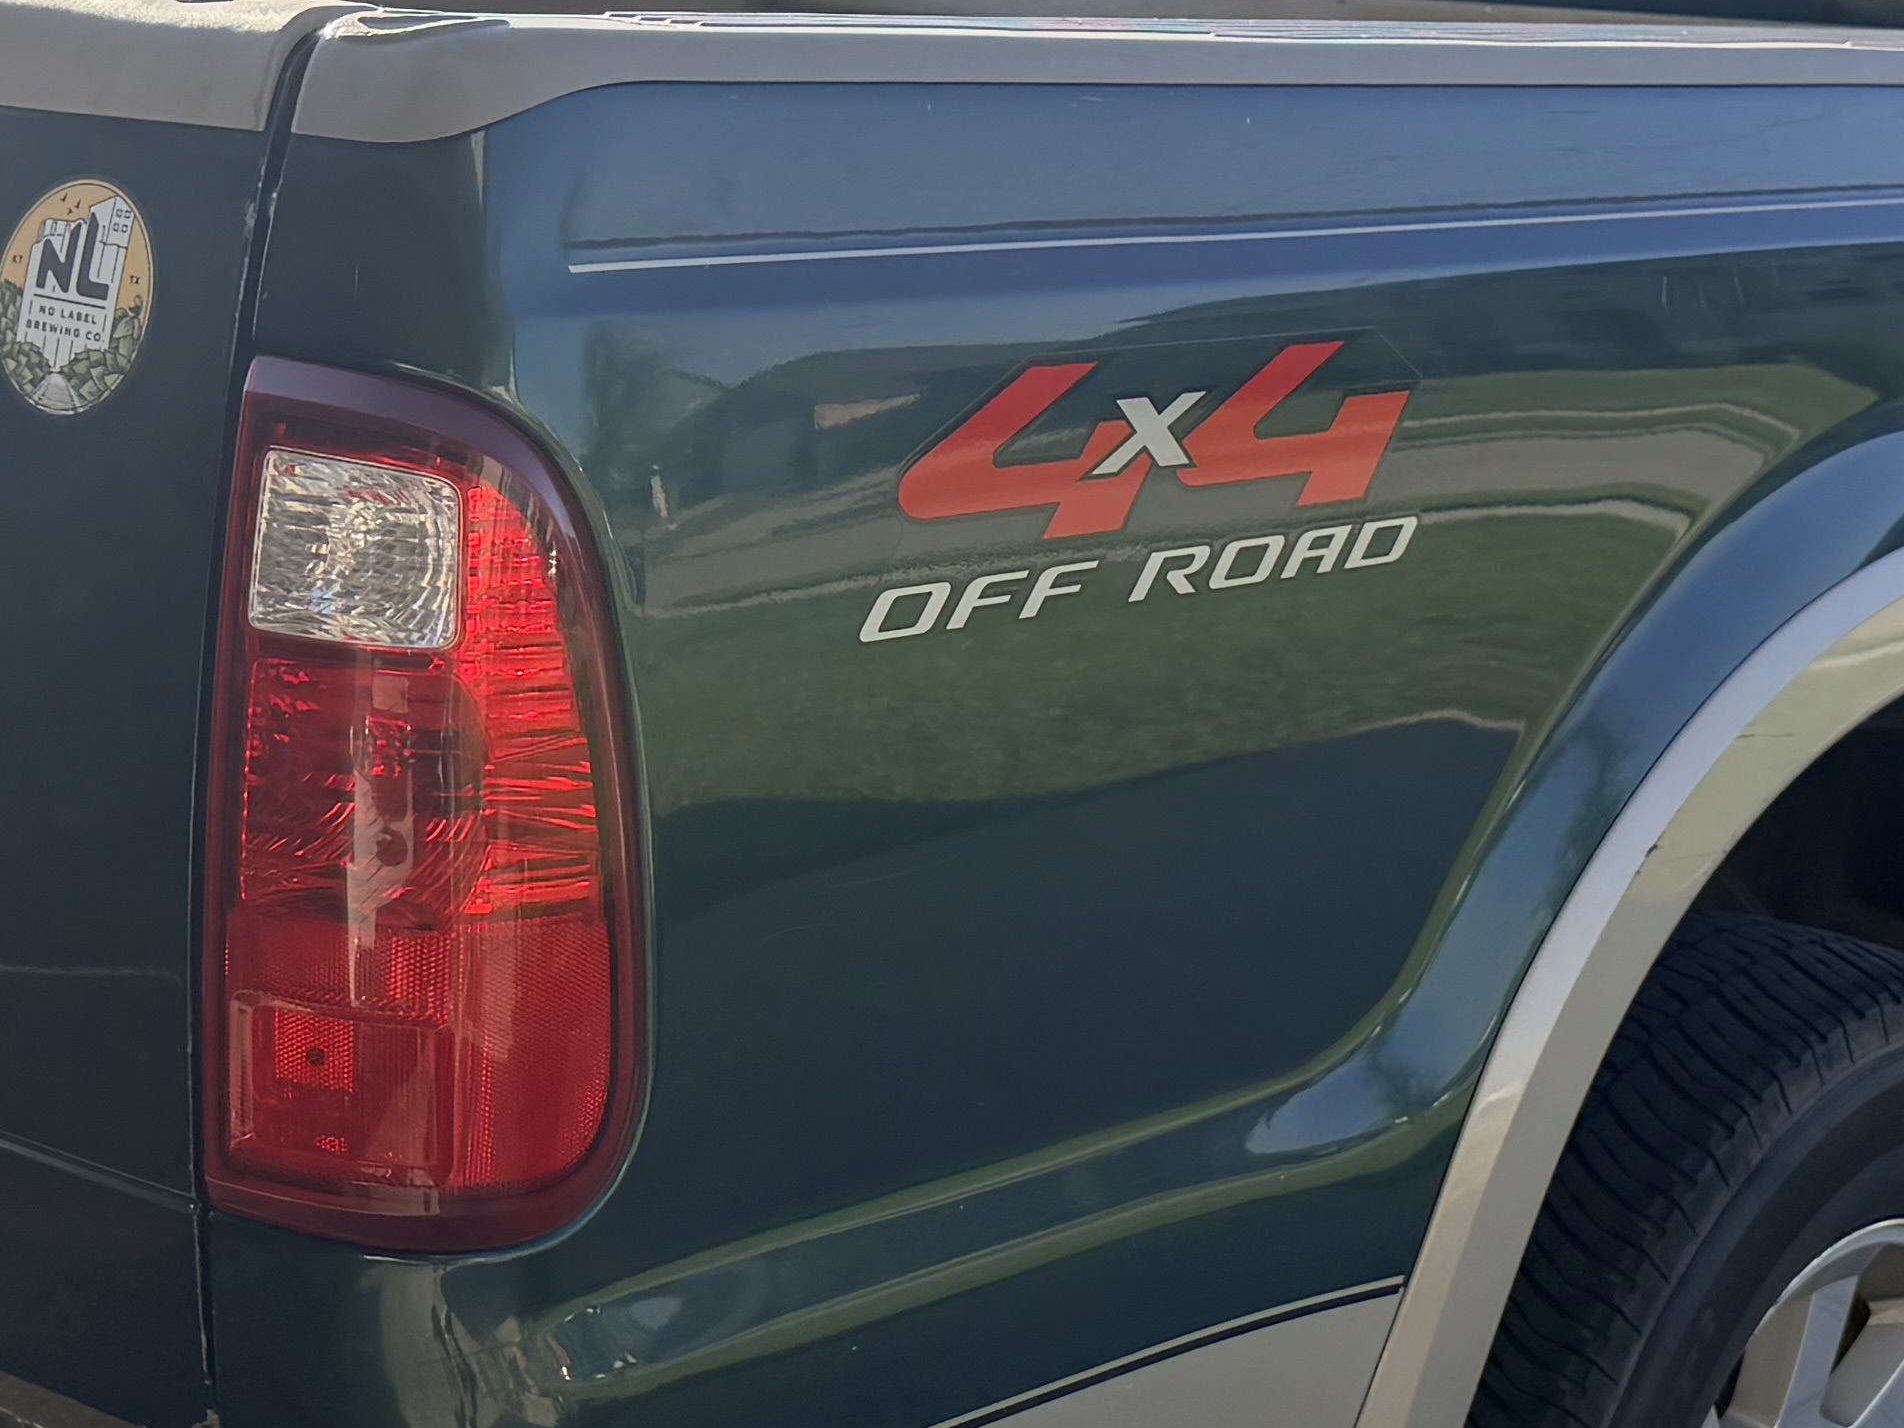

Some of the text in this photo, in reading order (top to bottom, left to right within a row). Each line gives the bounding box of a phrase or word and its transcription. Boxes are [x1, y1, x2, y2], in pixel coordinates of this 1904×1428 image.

[36, 212, 109, 301] NL
[26, 318, 81, 338] BREWING
[39, 305, 97, 325] NO LABEL
[859, 515, 1419, 643] OFF ROAD
